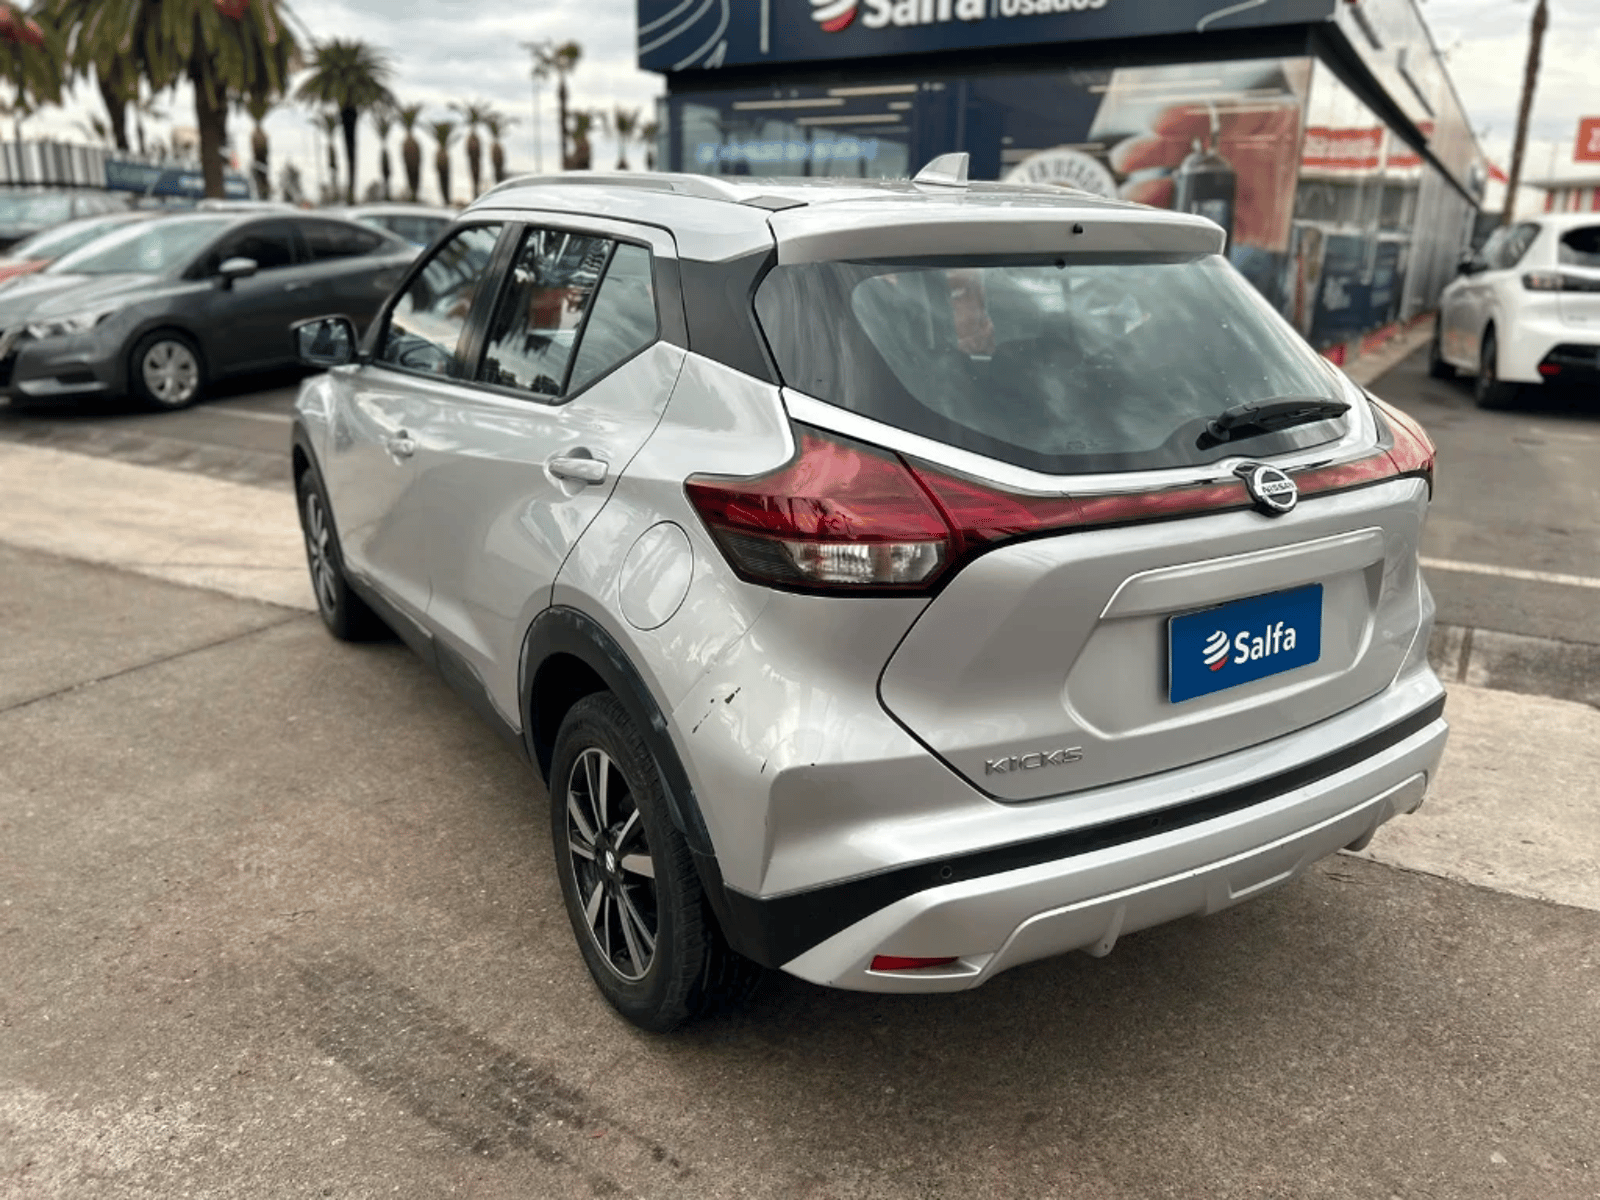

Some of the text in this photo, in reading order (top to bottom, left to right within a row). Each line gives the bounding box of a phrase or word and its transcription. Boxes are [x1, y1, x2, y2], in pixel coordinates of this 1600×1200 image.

[1261, 482, 1295, 494] NISSAN
[1234, 621, 1297, 664] Salfa
[984, 746, 1083, 776] KICKS
